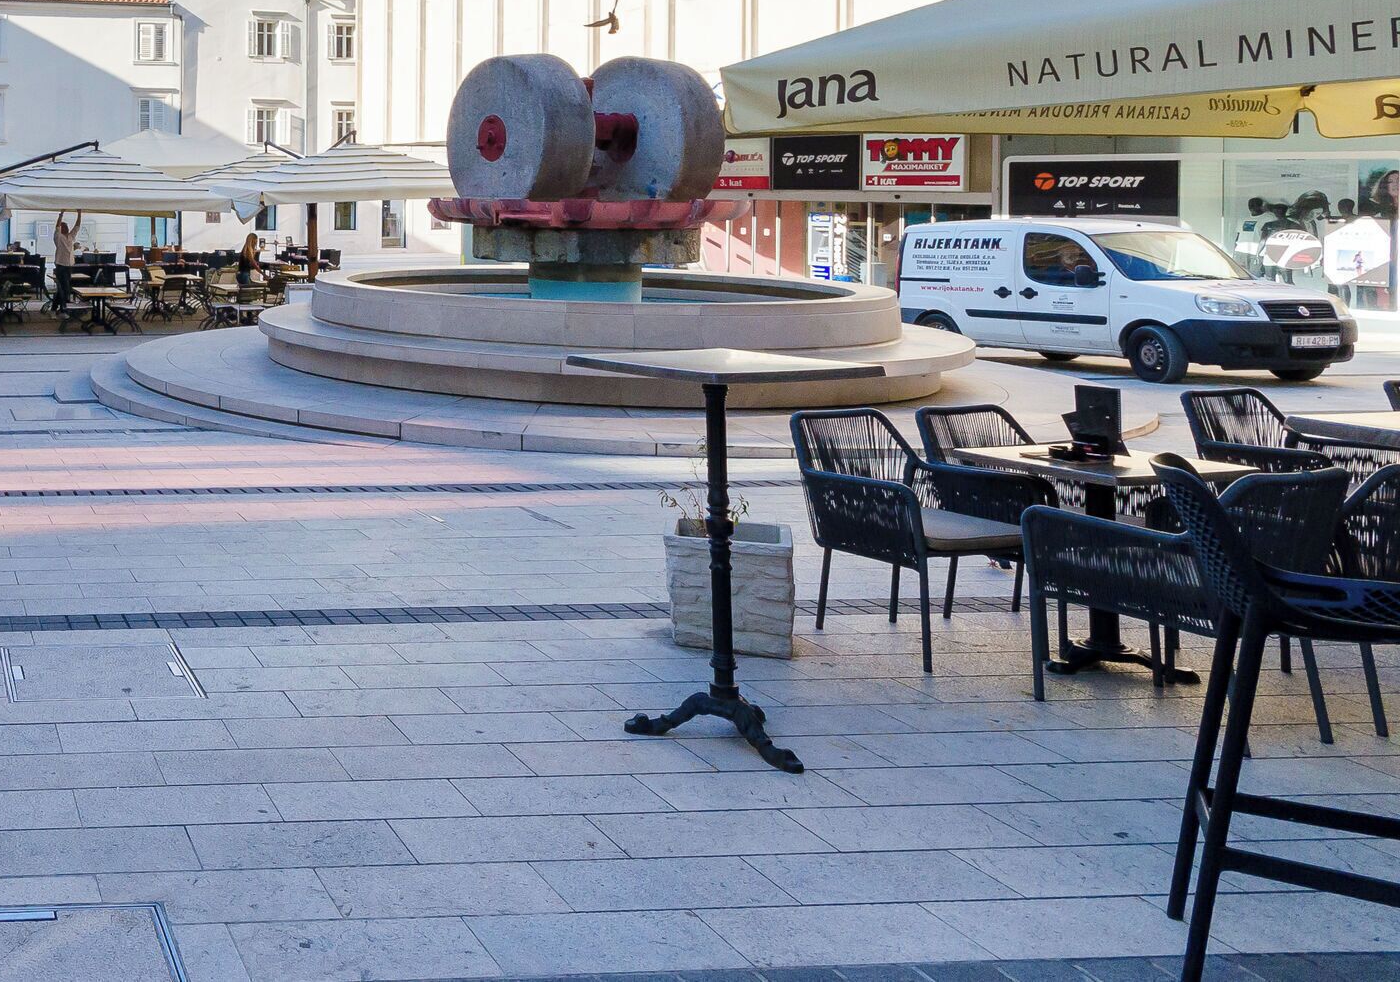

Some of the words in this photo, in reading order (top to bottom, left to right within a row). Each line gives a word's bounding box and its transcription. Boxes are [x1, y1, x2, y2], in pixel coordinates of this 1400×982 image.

[1006, 39, 1217, 87] NATURAL
[796, 155, 815, 164] TOP
[815, 154, 848, 163] SPORT
[891, 163, 944, 171] MAXIMARKET
[868, 176, 879, 185] -1
[880, 178, 898, 186] KAT
[1057, 176, 1088, 188] TOP
[1089, 176, 1145, 188] SPORT
[914, 237, 1002, 249] RIJEKATANK
